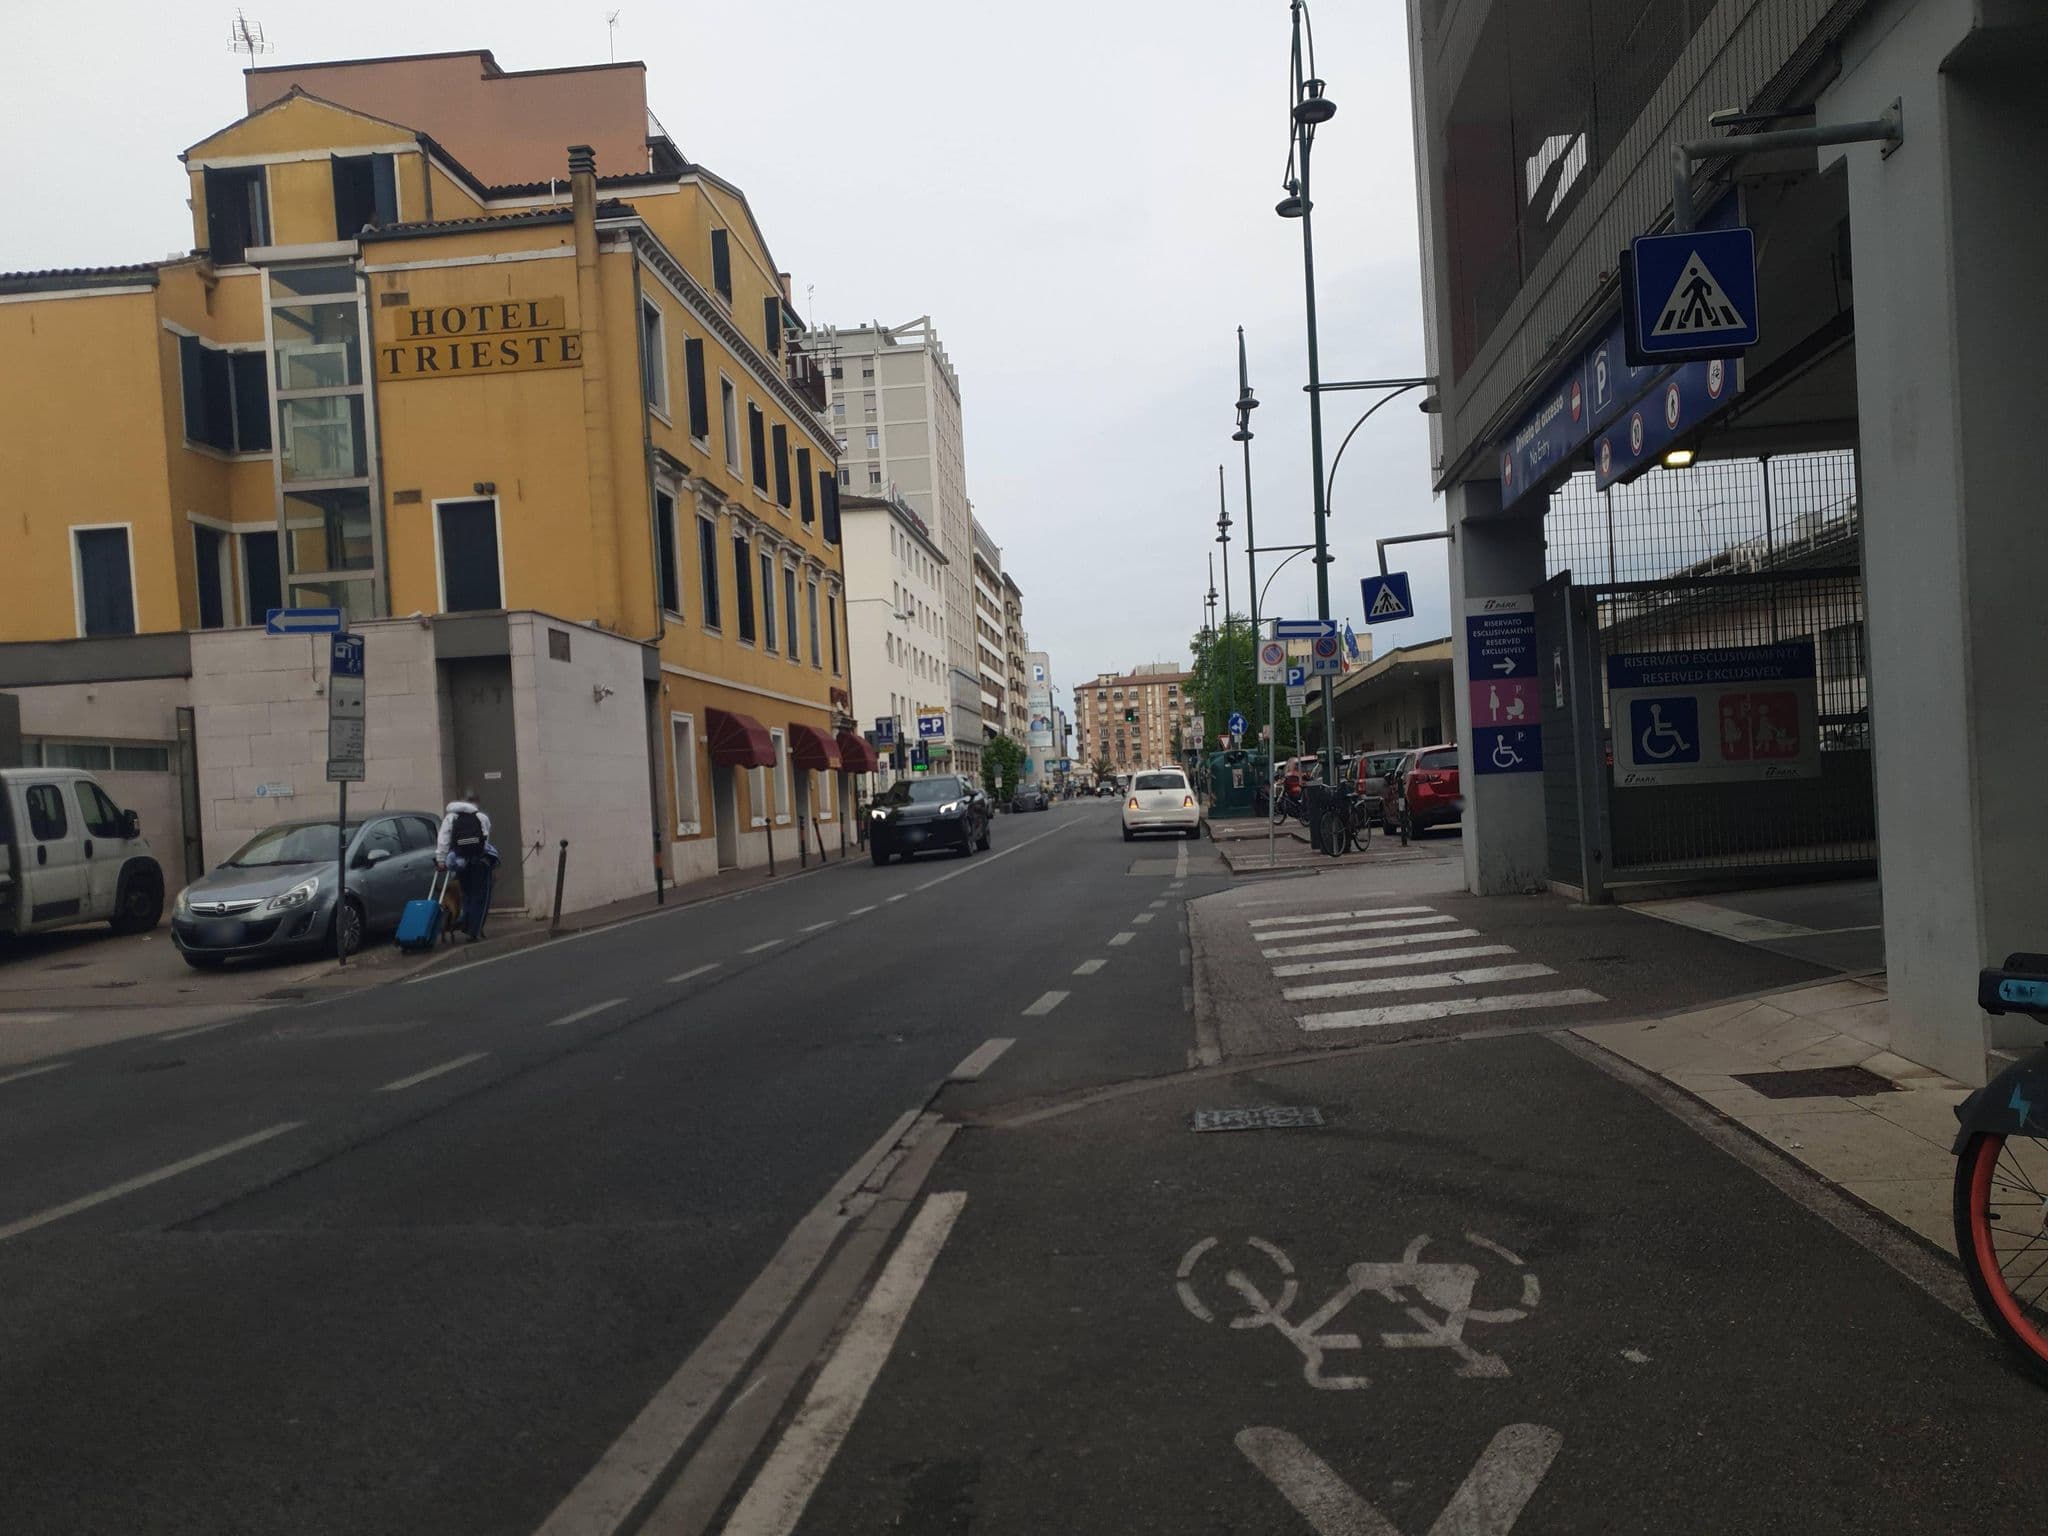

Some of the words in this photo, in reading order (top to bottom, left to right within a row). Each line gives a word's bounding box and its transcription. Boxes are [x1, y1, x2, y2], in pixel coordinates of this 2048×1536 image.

[410, 302, 549, 336] HOTEL
[383, 335, 582, 374] TRIESTE
[1597, 361, 1606, 405] P
[1516, 424, 1534, 454] Divieto
[1535, 412, 1542, 434] di
[1541, 394, 1564, 427] accesso
[1529, 448, 1538, 465] No
[1537, 440, 1550, 461] Entry
[1484, 618, 1522, 627] RISERVATO
[1473, 627, 1534, 637] ESCLUSIVAMENTE
[1486, 638, 1521, 646] RESERVED
[1482, 647, 1526, 656] EXCLUSIVELY
[1624, 653, 1690, 668] RISERVATO
[1693, 647, 1799, 665] ESCLUSIVAMENTE
[1034, 665, 1043, 681] P
[1289, 670, 1300, 685] P
[1642, 670, 1703, 684] RESERVED
[1707, 667, 1783, 681] EXCLUSIVELY
[877, 719, 891, 737] T
[932, 719, 942, 732] P
[1517, 732, 1524, 741] P
